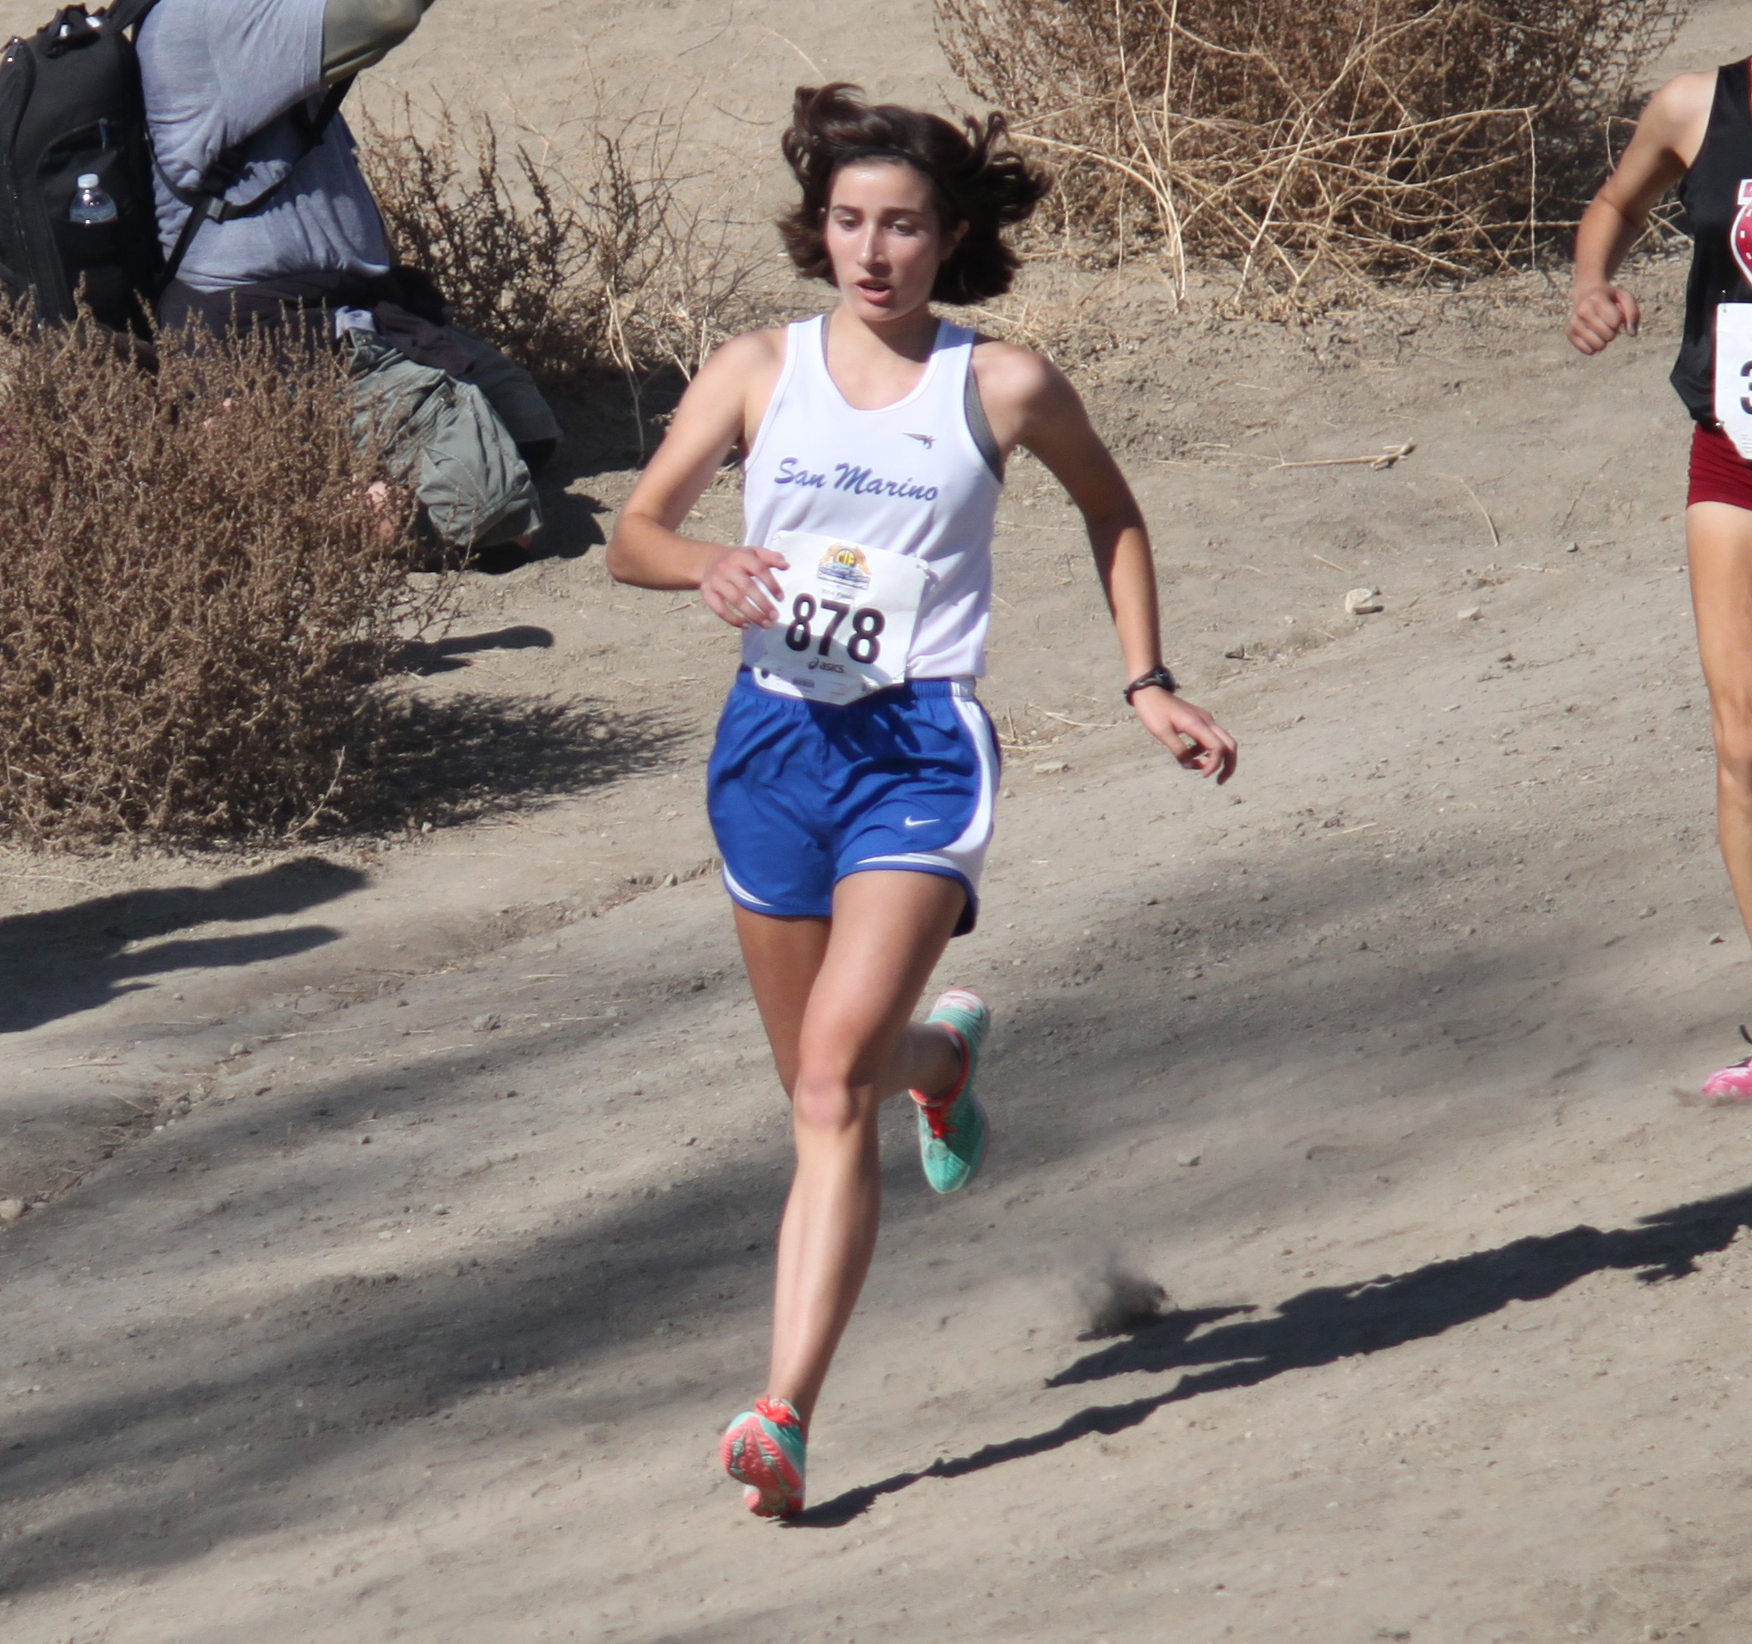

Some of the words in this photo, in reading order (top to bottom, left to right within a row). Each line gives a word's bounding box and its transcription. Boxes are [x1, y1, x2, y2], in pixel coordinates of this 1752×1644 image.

[774, 457, 827, 488] San
[834, 462, 939, 501] Marino
[785, 592, 886, 664] 878
